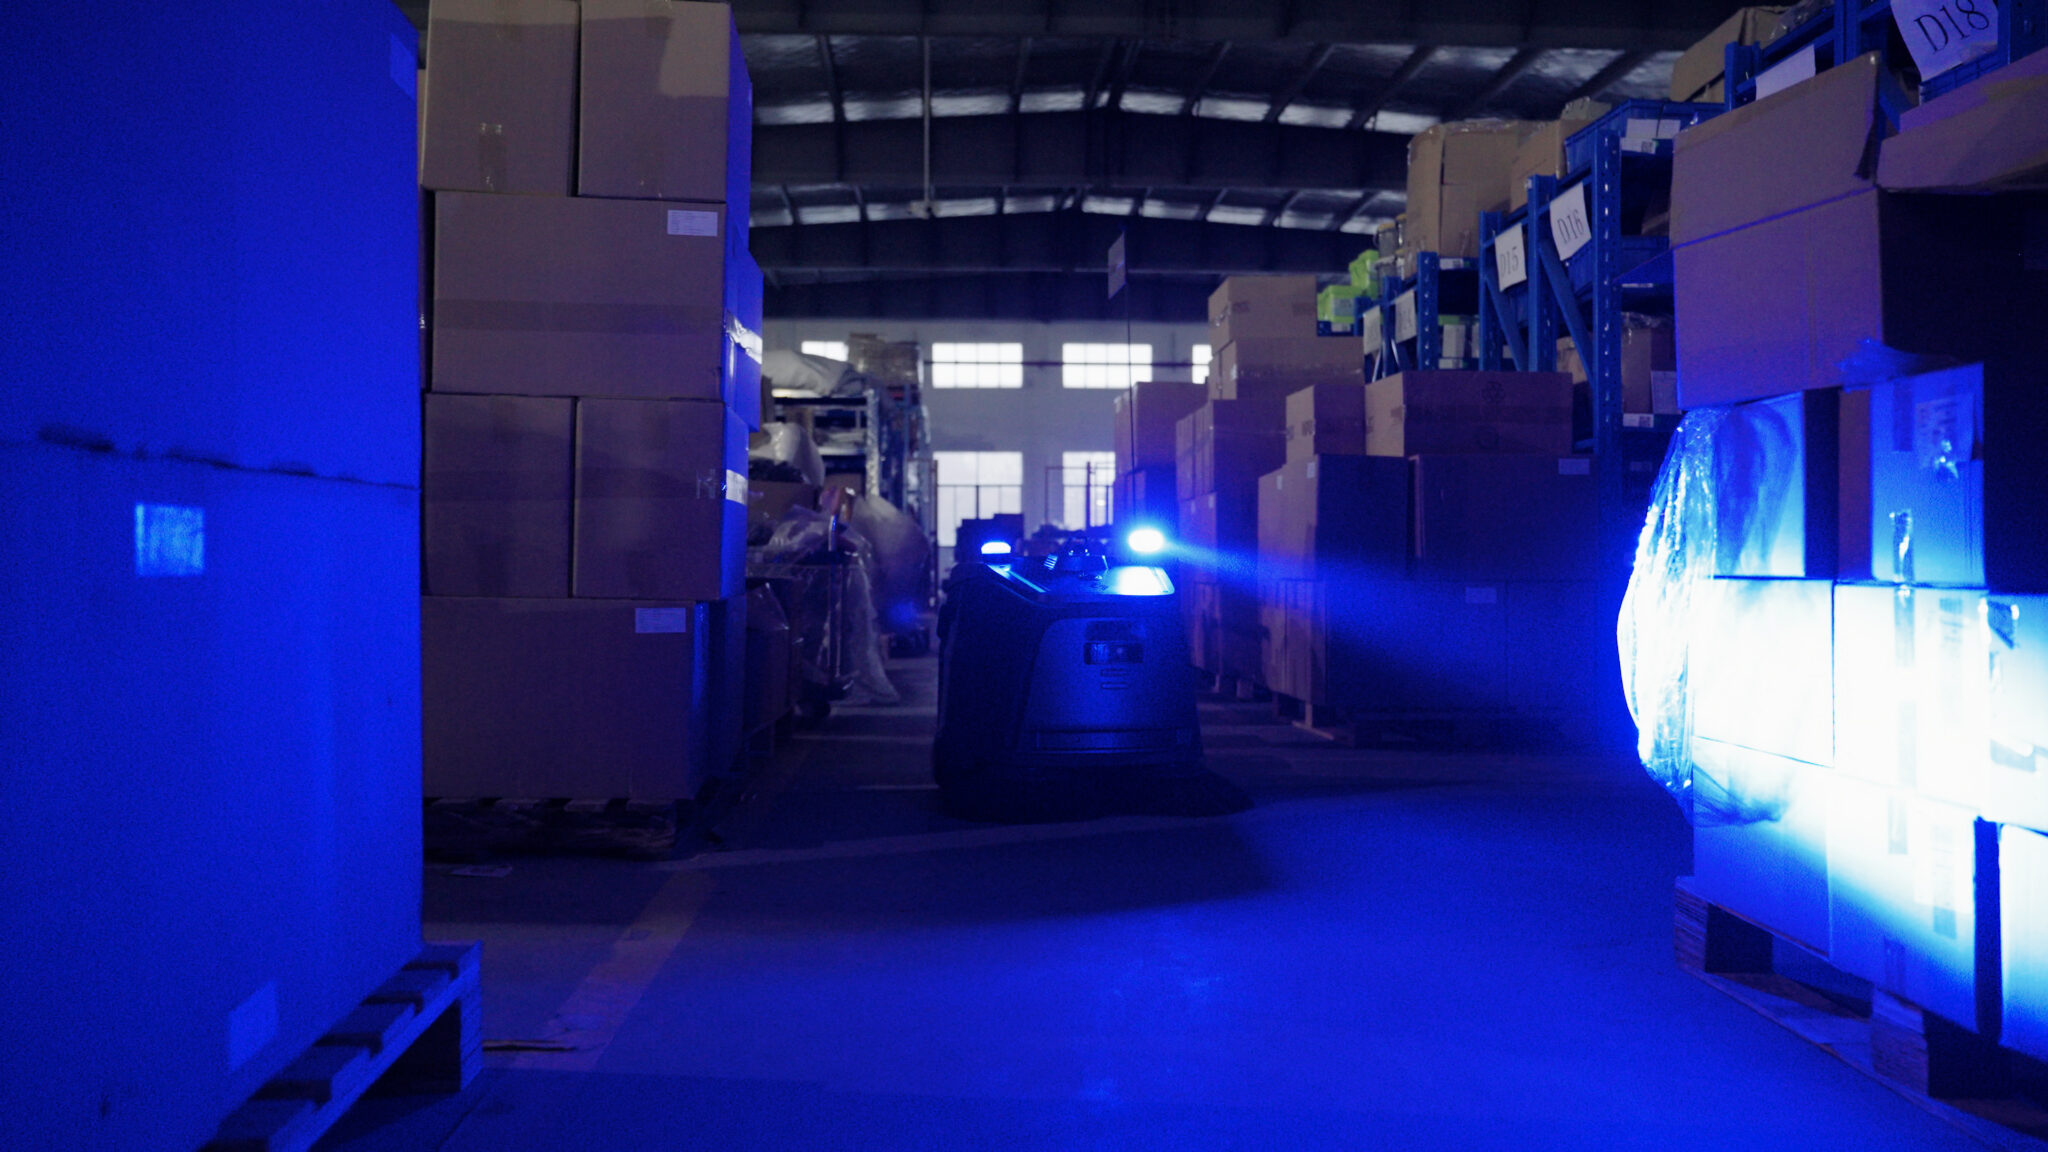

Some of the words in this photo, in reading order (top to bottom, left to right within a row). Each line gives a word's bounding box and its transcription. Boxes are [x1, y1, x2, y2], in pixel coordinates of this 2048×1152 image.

[1914, 0, 1990, 53] D18
[1556, 209, 1585, 245] D16
[1500, 246, 1520, 277] D15
